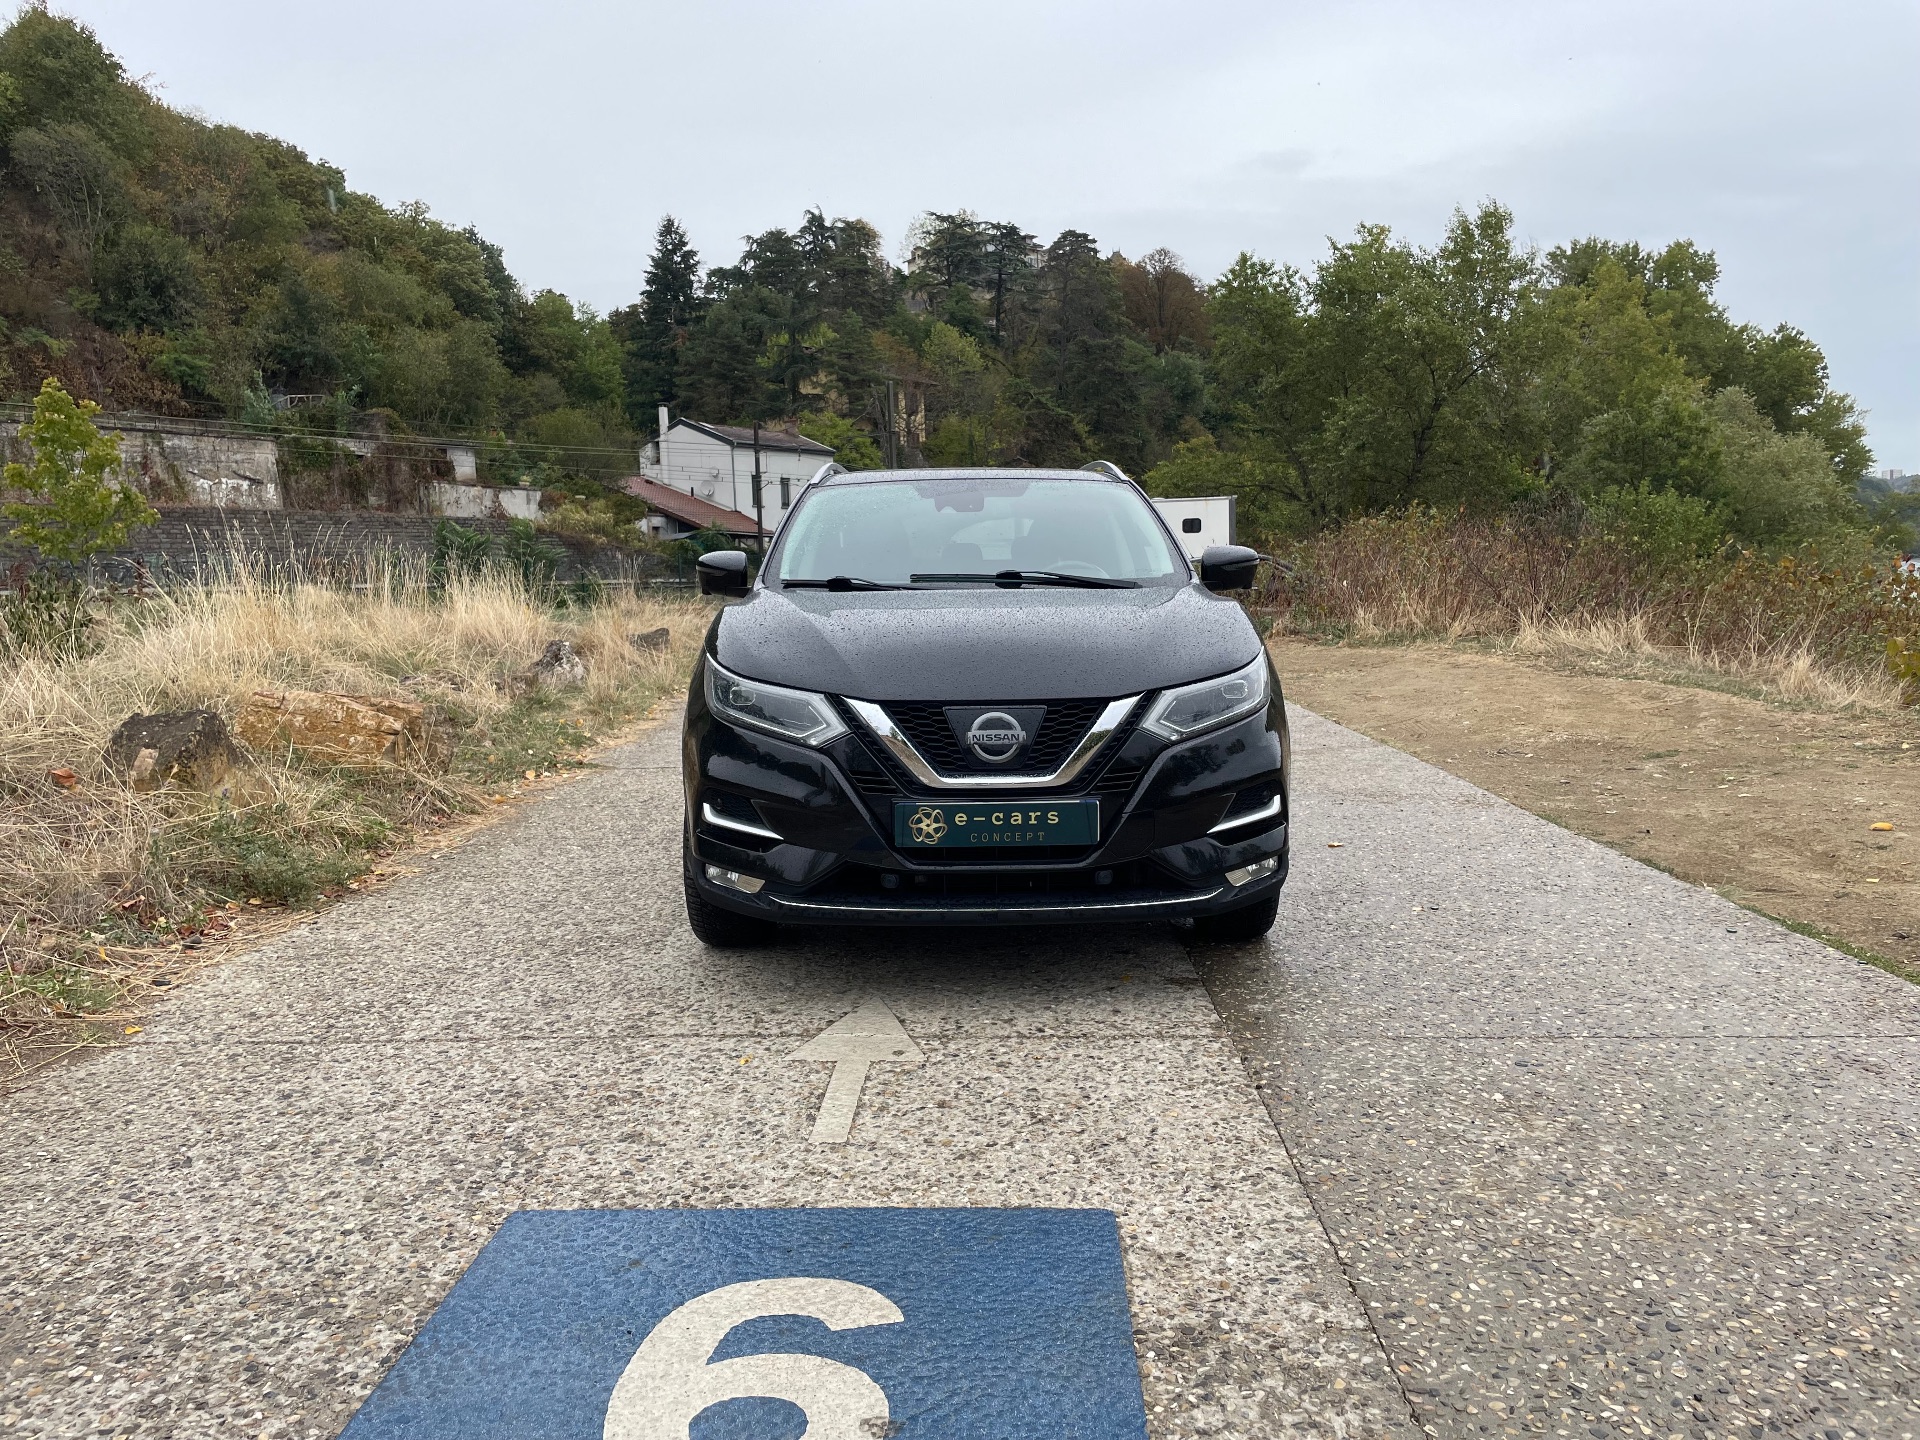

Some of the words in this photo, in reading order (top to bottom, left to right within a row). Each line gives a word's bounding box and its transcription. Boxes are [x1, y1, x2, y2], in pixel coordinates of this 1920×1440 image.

[972, 733, 1020, 742] NISSAN
[954, 810, 1059, 825] e-cars
[970, 832, 1046, 842] CONCEPT
[603, 1277, 904, 1440] 6
